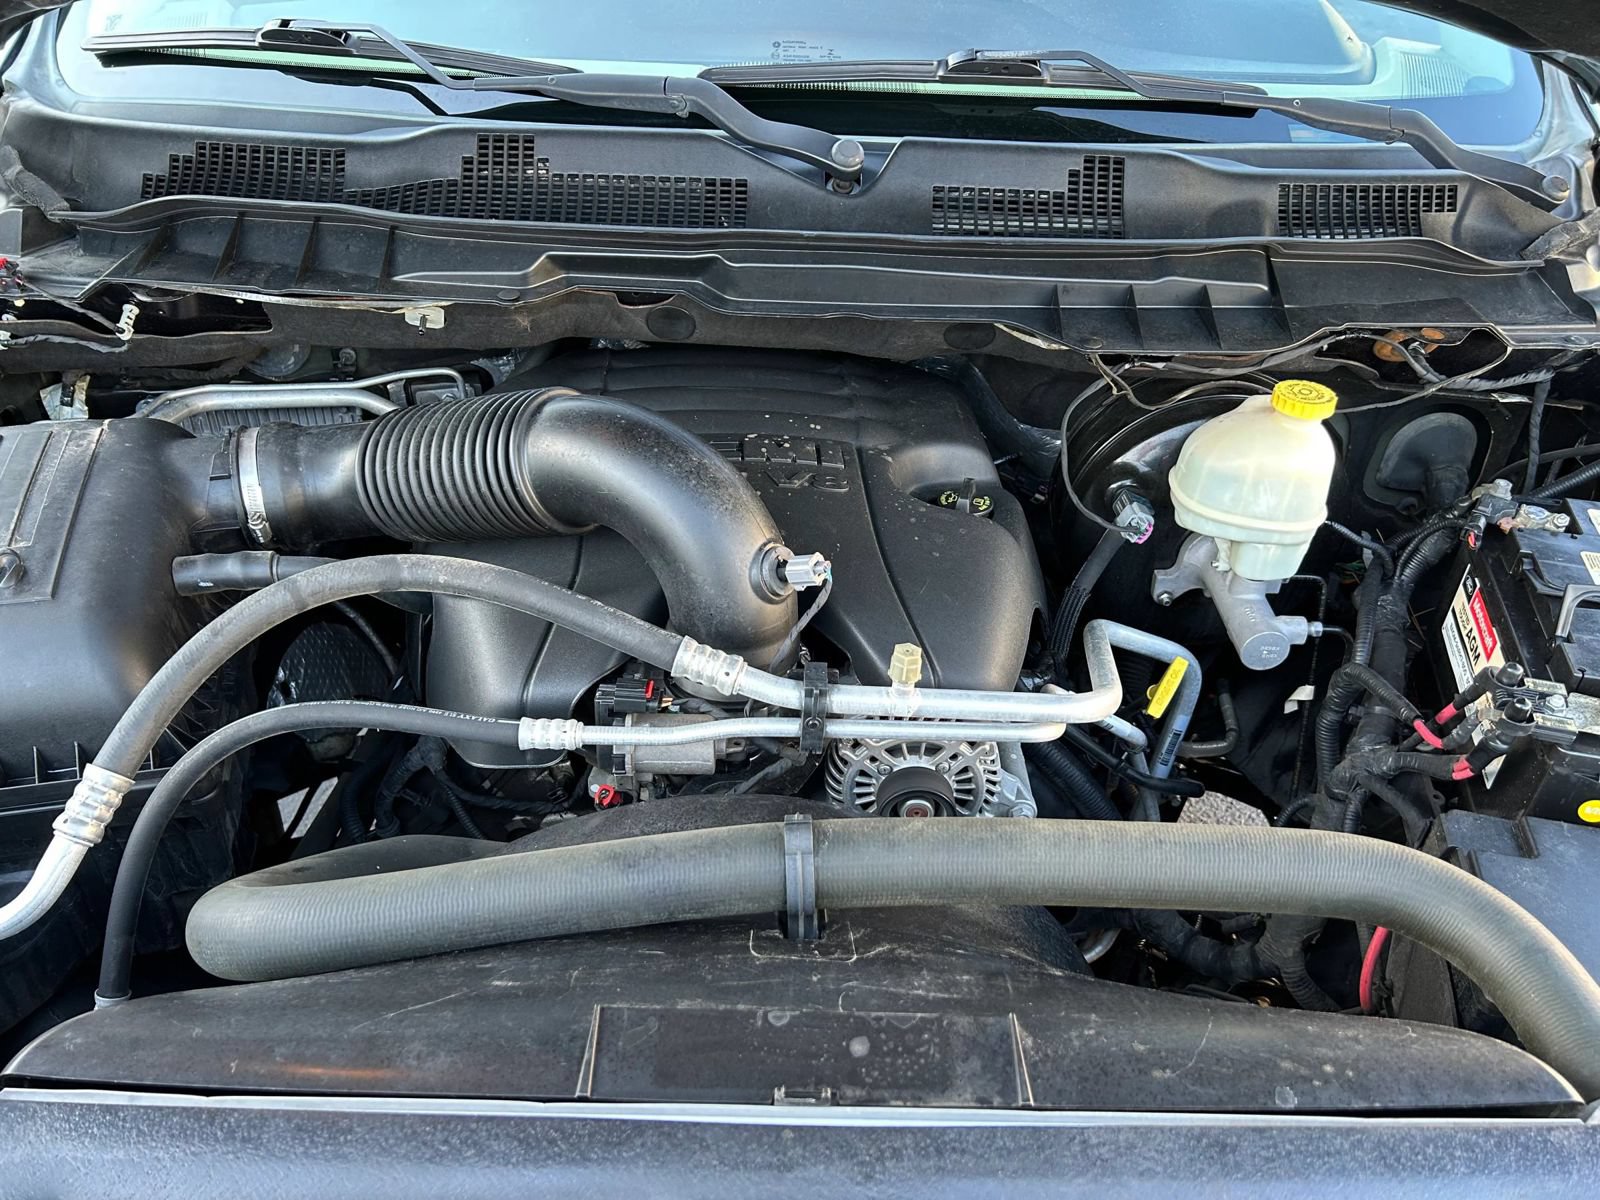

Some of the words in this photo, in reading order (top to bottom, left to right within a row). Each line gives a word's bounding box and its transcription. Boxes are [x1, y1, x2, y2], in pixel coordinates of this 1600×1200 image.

[1473, 597, 1494, 654] Motorcraft
[1465, 628, 1481, 667] AGM
[456, 713, 496, 723] GALAXY
